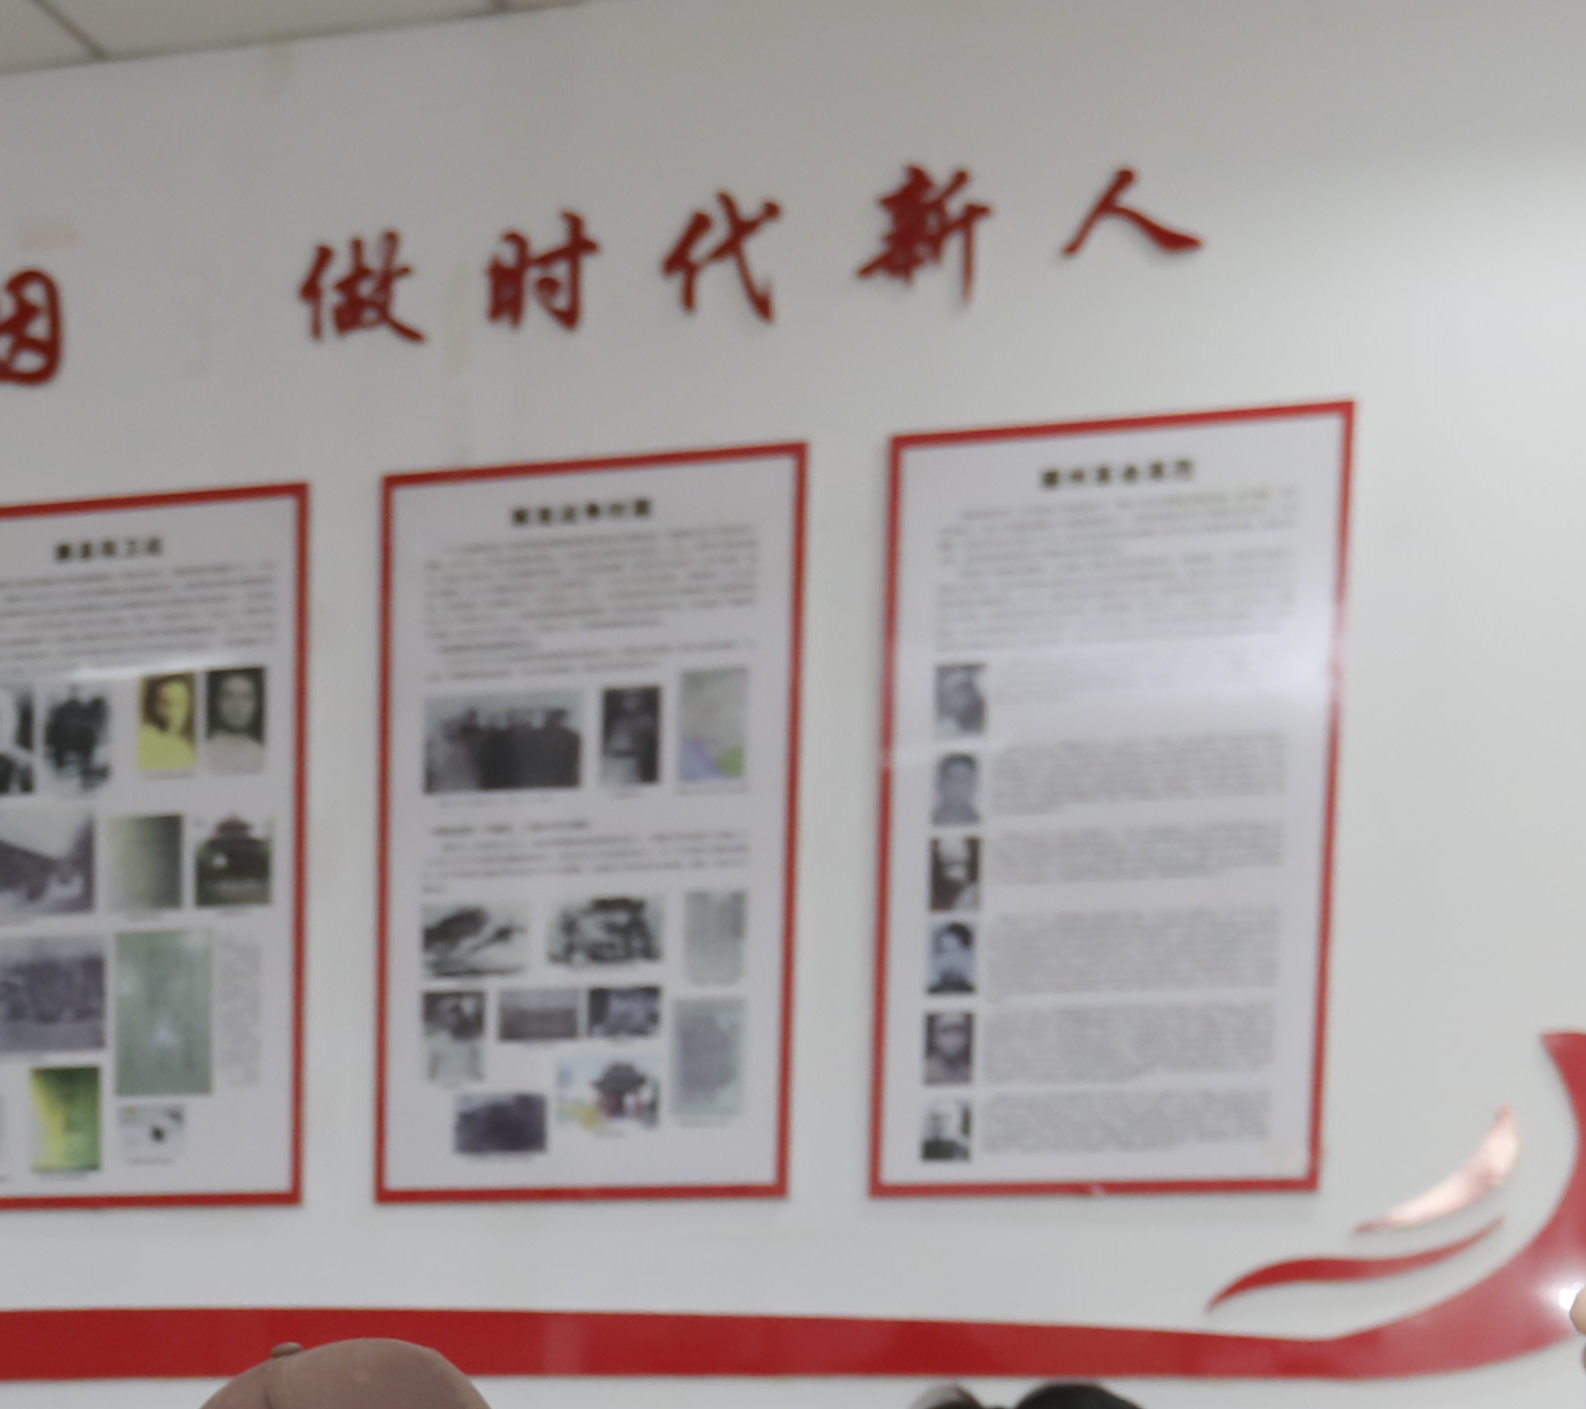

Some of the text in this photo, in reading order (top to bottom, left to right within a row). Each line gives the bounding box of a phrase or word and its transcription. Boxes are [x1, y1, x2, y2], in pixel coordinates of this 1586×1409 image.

[298, 162, 1205, 343] 做时代新人
